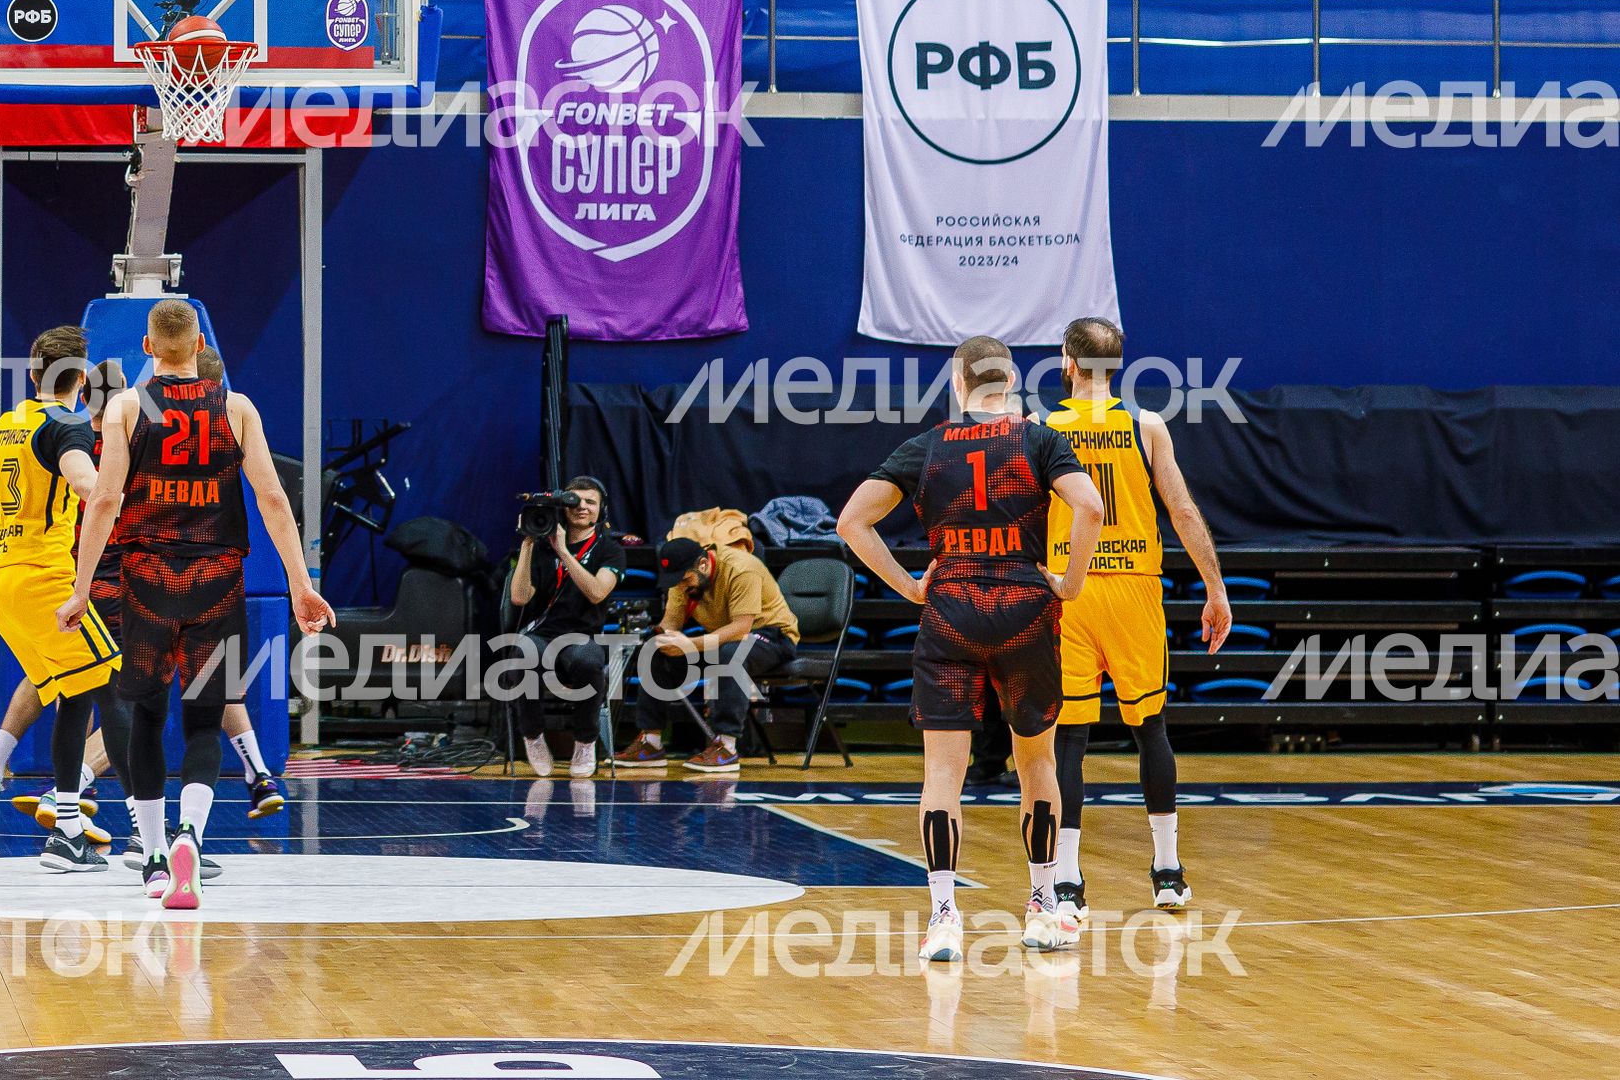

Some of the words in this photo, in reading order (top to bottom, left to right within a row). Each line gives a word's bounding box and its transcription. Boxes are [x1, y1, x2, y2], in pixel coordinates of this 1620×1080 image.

[14, 9, 52, 25] РФБ
[915, 39, 1057, 91] РФБ
[556, 101, 675, 127] FONBET
[574, 202, 657, 222] ЛИГА
[936, 213, 1041, 228] РОССИЙСКАЯ
[899, 232, 984, 249] ФЕДЕРАЦИЯ
[988, 232, 1081, 248] БАСКЕТБОЛА
[958, 254, 1020, 268] 2023/24
[161, 408, 211, 466] 21
[943, 421, 1011, 442] МАКЕЕВ
[1061, 430, 1133, 450] ЮЧНИКОВ
[965, 449, 988, 511] 1
[149, 477, 221, 508] РЕВДА
[944, 526, 1023, 557] РЕВДА
[1053, 539, 1148, 558] МООВСКАЯ
[1088, 556, 1135, 570] ЛАСТЬ
